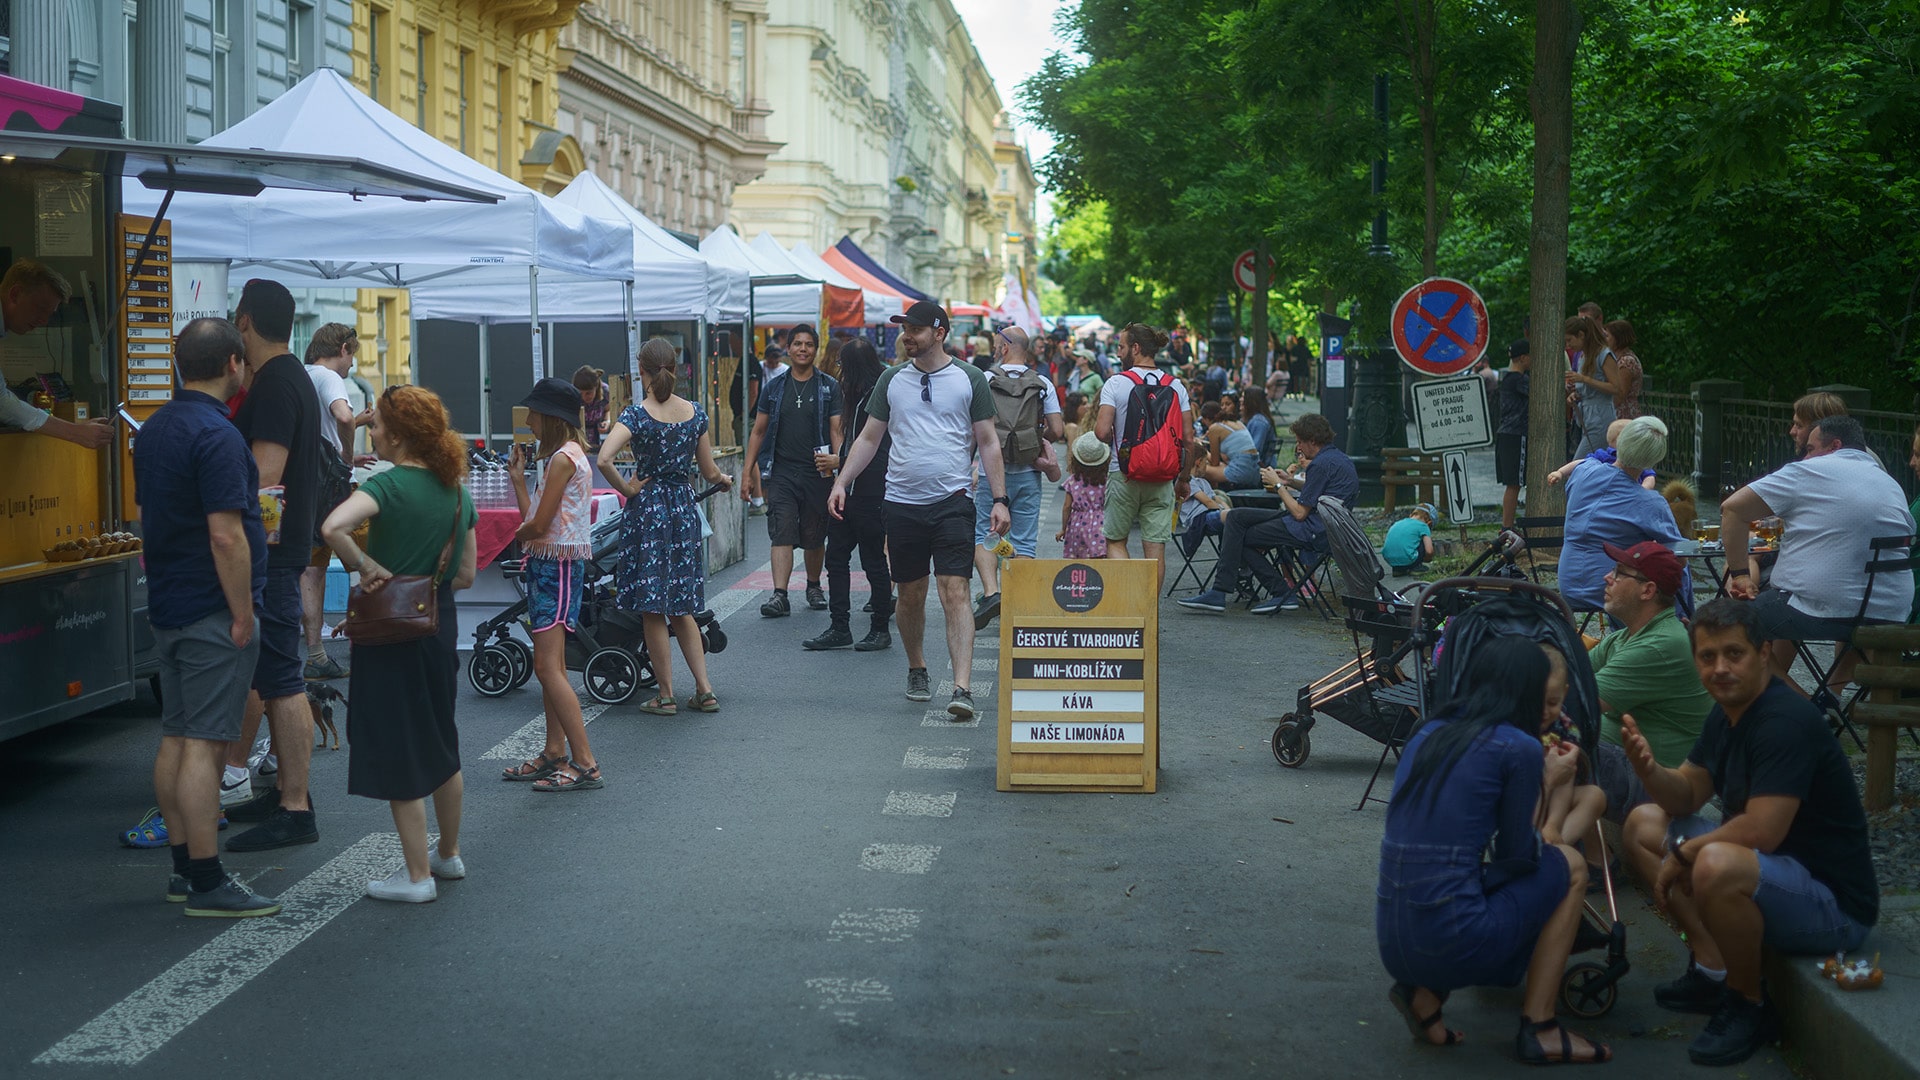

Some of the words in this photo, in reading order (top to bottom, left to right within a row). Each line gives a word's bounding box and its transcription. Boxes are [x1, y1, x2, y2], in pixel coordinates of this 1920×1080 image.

[1329, 337, 1339, 353] P
[1424, 387, 1445, 398] UNITED
[1446, 383, 1471, 394] ISLANDS
[1432, 398, 1441, 407] OF
[1442, 395, 1464, 405] PRAGUE
[1437, 405, 1464, 417] 11.6.2022
[1430, 420, 1439, 428] od
[1439, 418, 1452, 427] 6.00
[1458, 414, 1474, 424] 24.00
[1071, 569, 1087, 584] GU
[1016, 629, 1068, 648] ČERSTVÉ
[1072, 629, 1140, 648] TVAROHOVÉ
[1033, 661, 1123, 679] MINI-KOBLÍŽKY
[1062, 692, 1093, 709] KÁVA
[1030, 723, 1061, 741] NAŠE
[1065, 724, 1125, 742] LIMONÁDA
